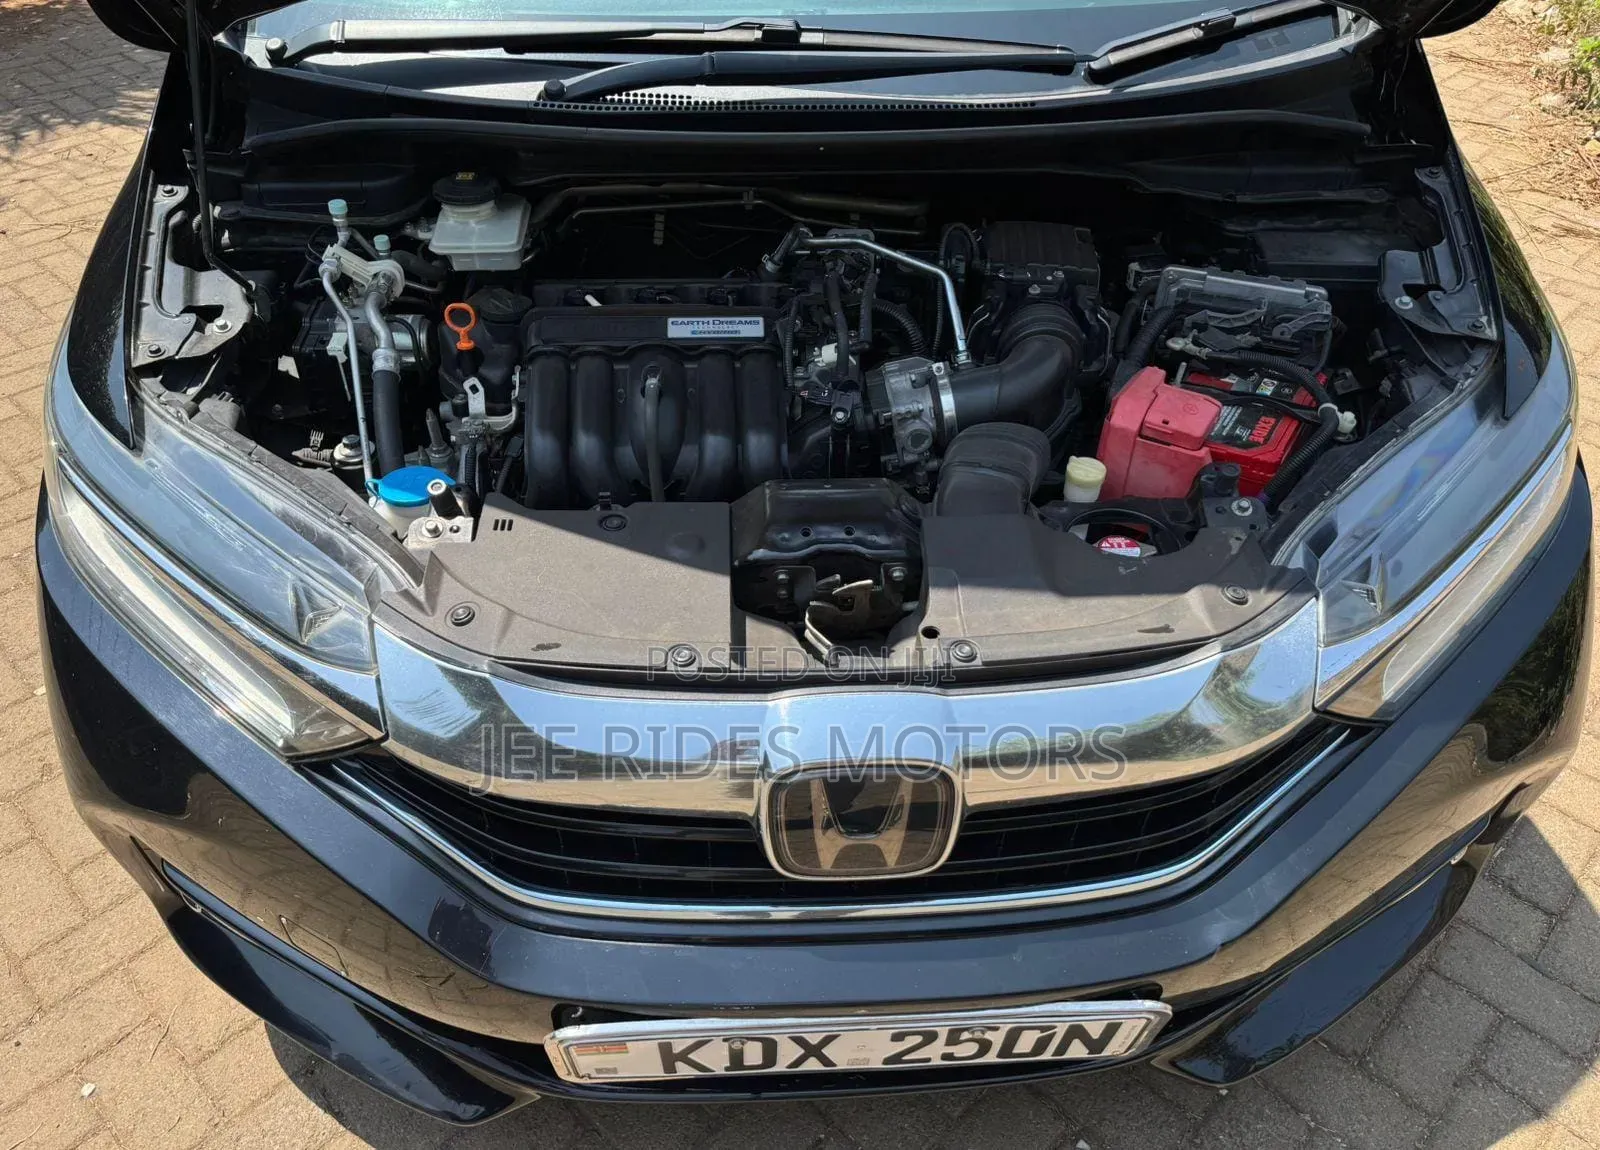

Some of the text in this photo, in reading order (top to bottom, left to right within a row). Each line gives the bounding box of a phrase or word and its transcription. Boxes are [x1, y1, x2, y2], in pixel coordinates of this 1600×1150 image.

[1248, 416, 1277, 444] EXIDE
[657, 1034, 841, 1074] KDX
[882, 1022, 1124, 1066] 250N
